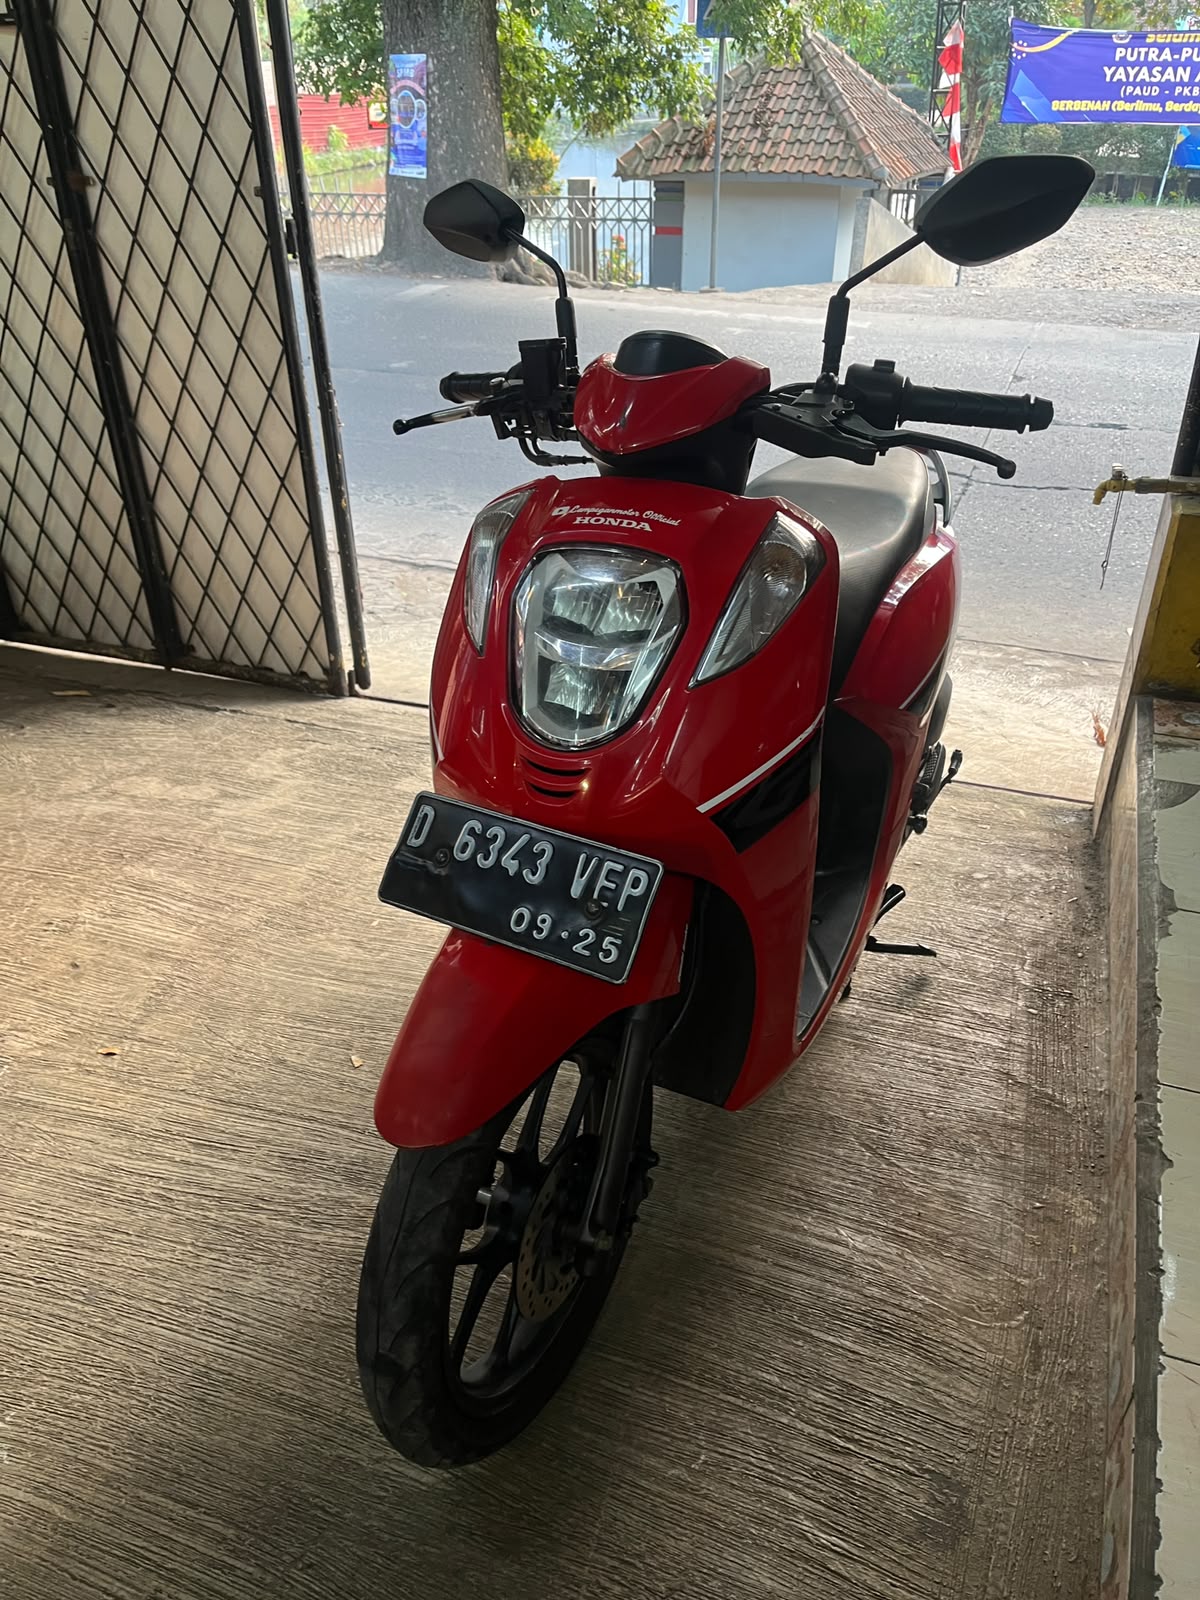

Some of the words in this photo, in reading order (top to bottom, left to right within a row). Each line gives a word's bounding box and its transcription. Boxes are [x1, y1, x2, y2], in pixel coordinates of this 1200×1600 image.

[1102, 66, 1191, 82] YAYASAN
[1120, 86, 1160, 97] (PAUD
[1051, 100, 1110, 111] BERBENAH
[1111, 100, 1163, 113] (Berilmu,
[1164, 100, 1200, 114] Berda
[572, 516, 653, 532] HONDA
[642, 510, 681, 526] Official
[406, 804, 436, 848] D
[454, 820, 554, 884] 6343
